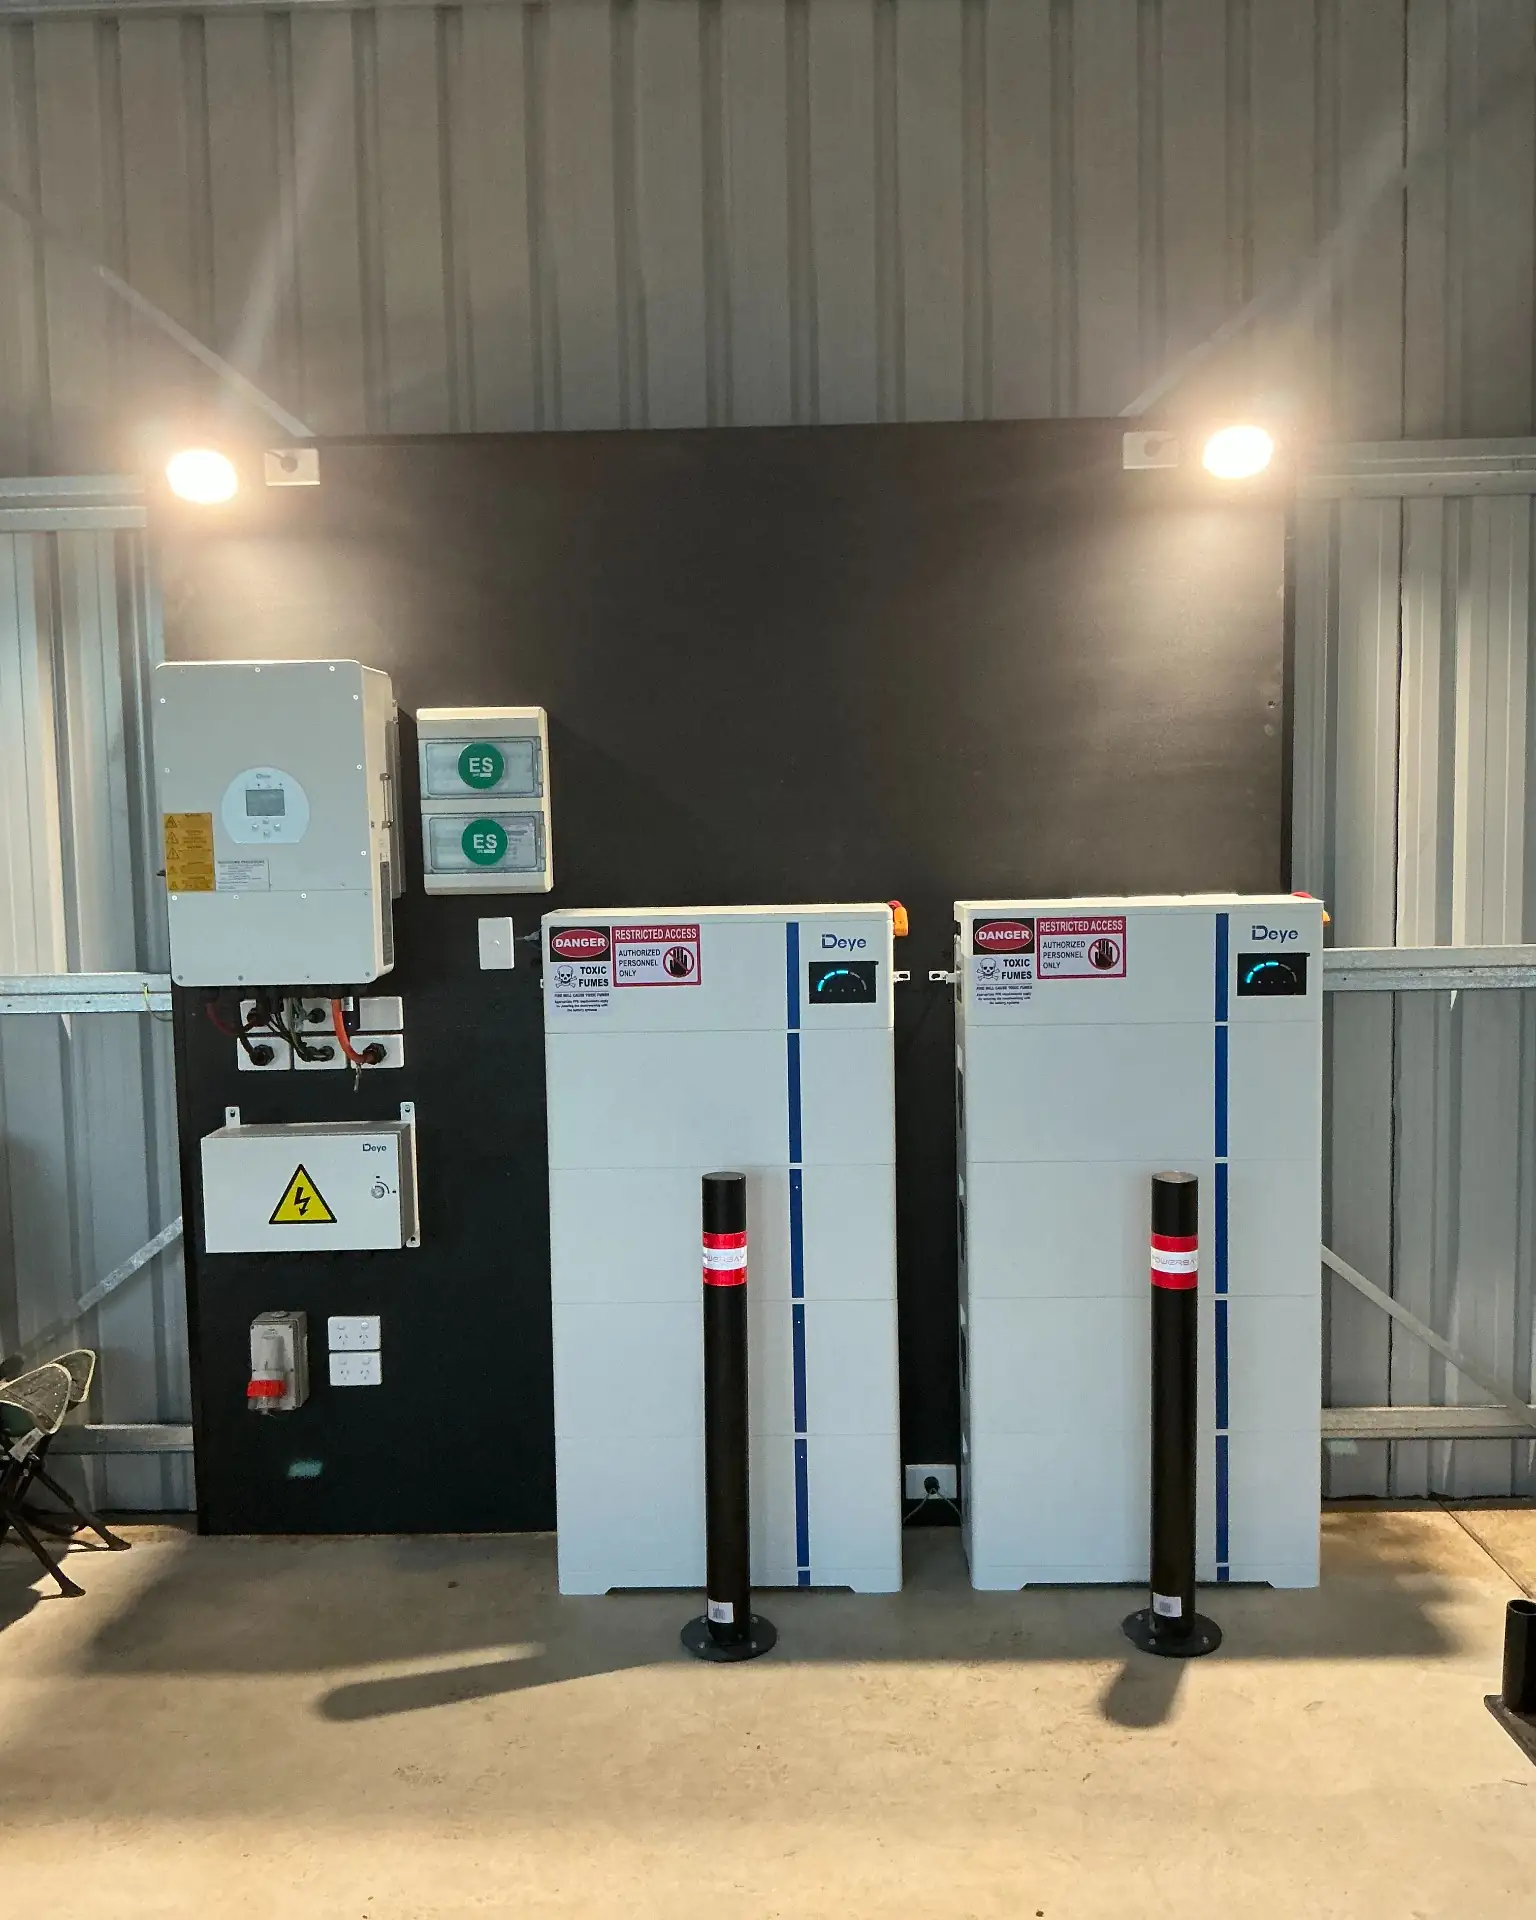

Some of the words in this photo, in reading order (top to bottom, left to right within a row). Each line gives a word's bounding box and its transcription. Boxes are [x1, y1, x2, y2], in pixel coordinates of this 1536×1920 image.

[469, 757, 494, 773] ES
[473, 833, 498, 849] ES
[1040, 921, 1089, 932] RESTRICTED
[1090, 920, 1123, 931] ACCESS
[615, 929, 664, 940] RESTRICTED
[665, 928, 697, 939] ACCESS
[979, 930, 1030, 940] DANGER
[1251, 925, 1298, 943] Deye
[555, 937, 606, 948] DANGER
[822, 933, 867, 952] Deye
[1042, 940, 1086, 949] AUTHORIZED
[618, 949, 661, 957] AUTHORIZED
[1042, 951, 1084, 959] PERSONNEL
[618, 959, 659, 967] PERSONNEL
[1003, 958, 1031, 968] TOXIC
[1042, 961, 1061, 970] ONLY
[580, 966, 607, 975] TOXIC
[619, 969, 637, 978] ONLY
[1001, 970, 1032, 980] FUMES
[578, 978, 609, 988] FUMES
